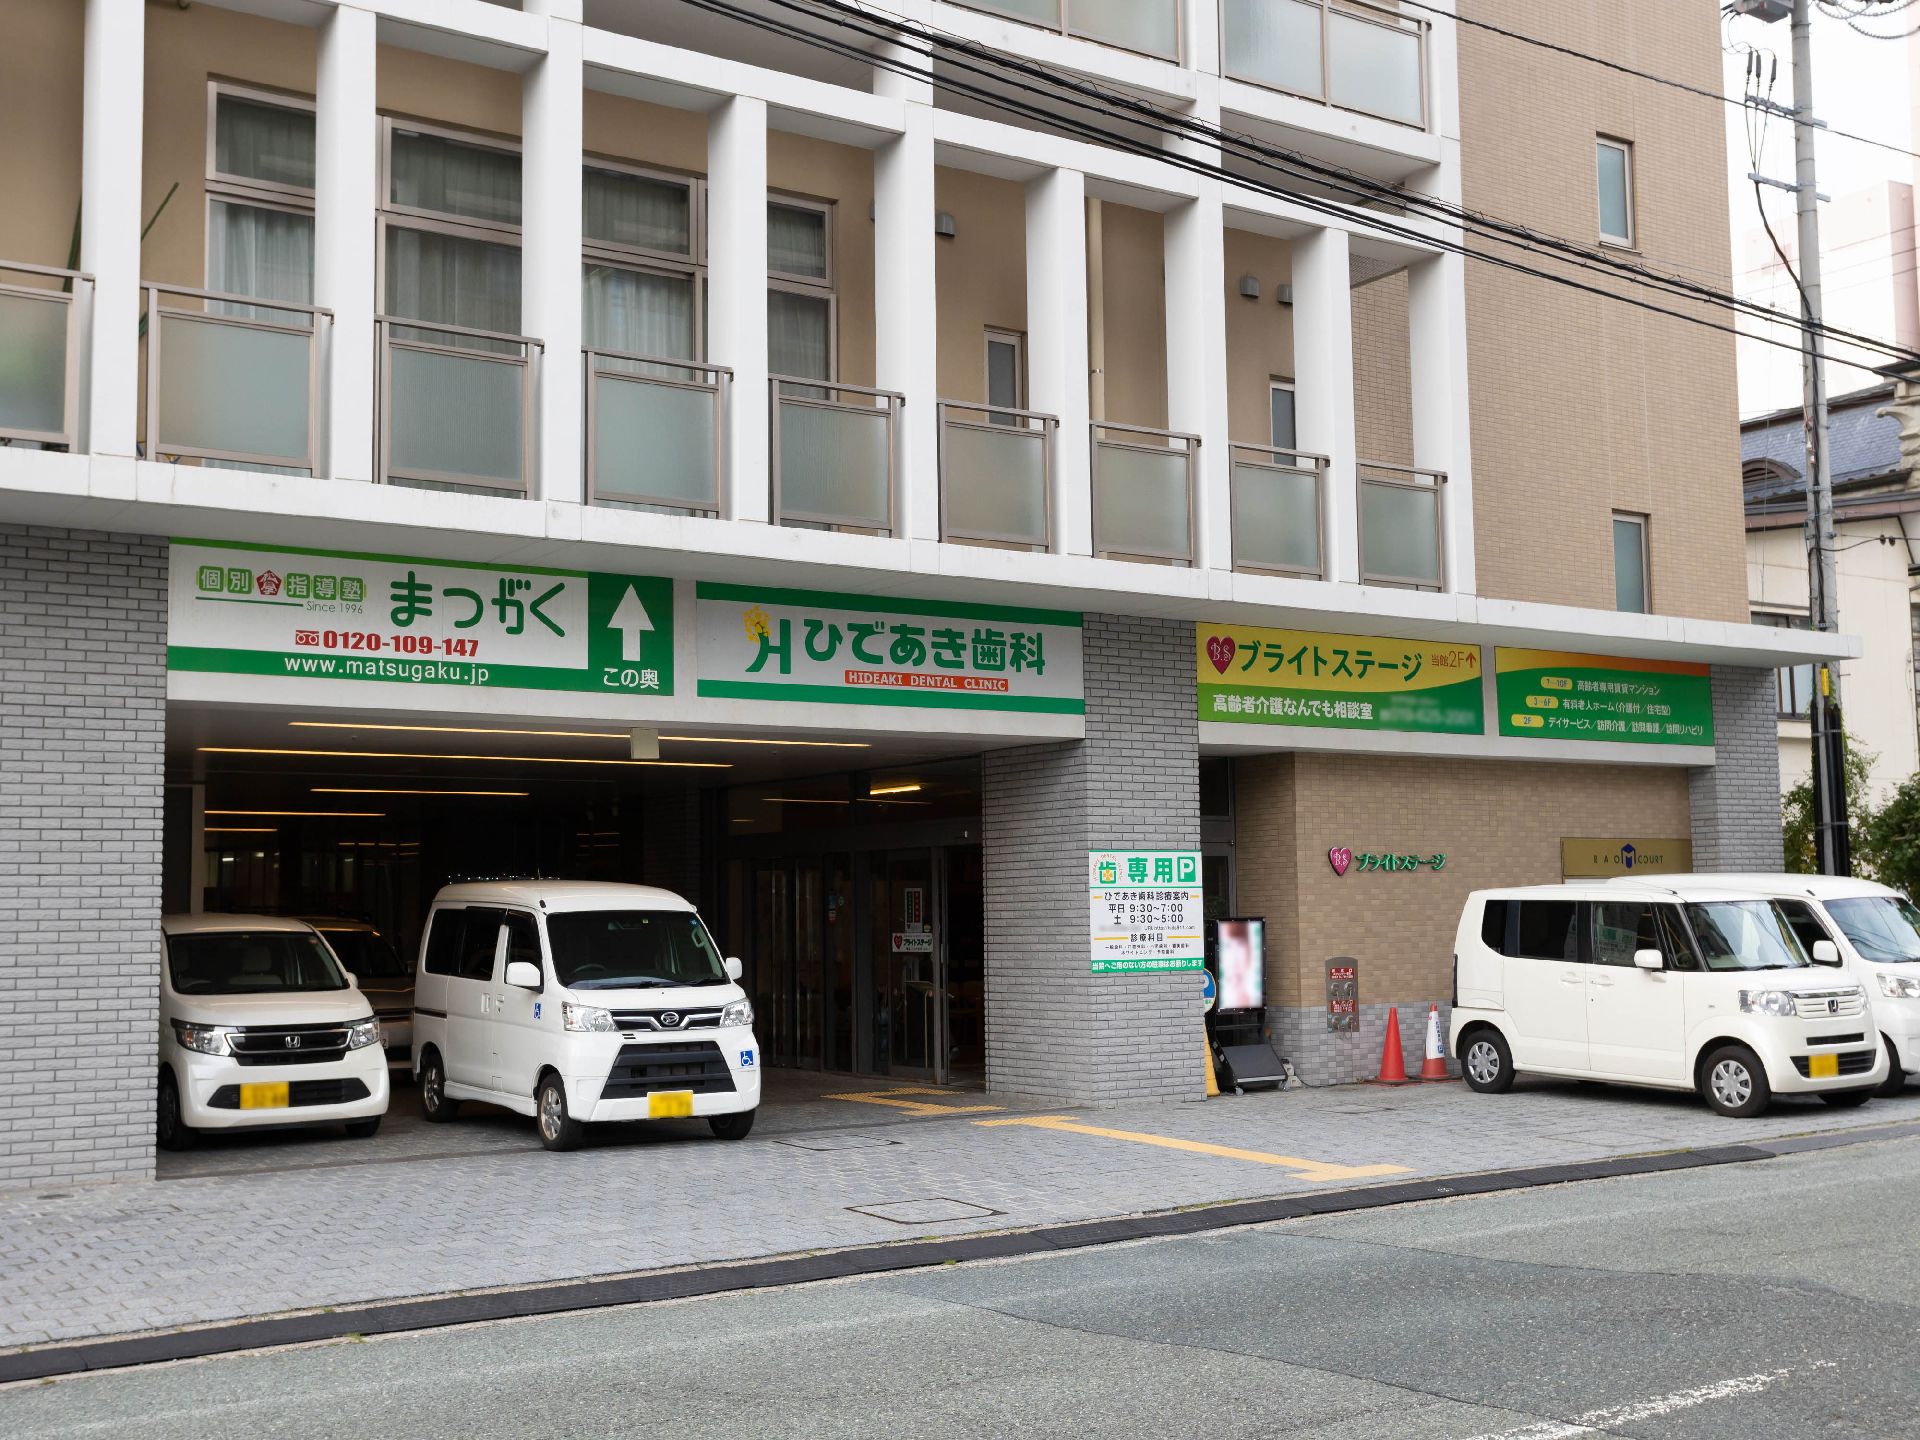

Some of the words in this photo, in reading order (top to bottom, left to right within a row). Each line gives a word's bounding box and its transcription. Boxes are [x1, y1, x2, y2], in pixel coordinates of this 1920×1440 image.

[201, 567, 250, 592] 個別
[287, 576, 363, 601] 指導塾
[306, 600, 336, 613] Since
[339, 602, 364, 615] 1996
[390, 570, 567, 638] まつがく
[323, 630, 479, 657] 0120-109-147
[803, 618, 1046, 676] ひであき歯科
[284, 656, 490, 685] www.matsugaku.jp
[1238, 640, 1422, 682] ブライトステージ
[603, 668, 660, 690] この奥
[848, 671, 903, 686] HIDEAKI
[910, 675, 957, 688] DENTAL
[964, 678, 1006, 691] CLINIC
[1213, 694, 1374, 720] 高齢者介護なんでも相談室
[1523, 716, 1533, 725] 2F
[1355, 853, 1448, 871] ブライトステージ
[1638, 855, 1664, 864] COURT
[1104, 891, 1189, 901] ひであき歯科診療案内
[1108, 903, 1125, 913] 平日
[1113, 914, 1122, 924] 土
[1130, 932, 1163, 942] 診療科目
